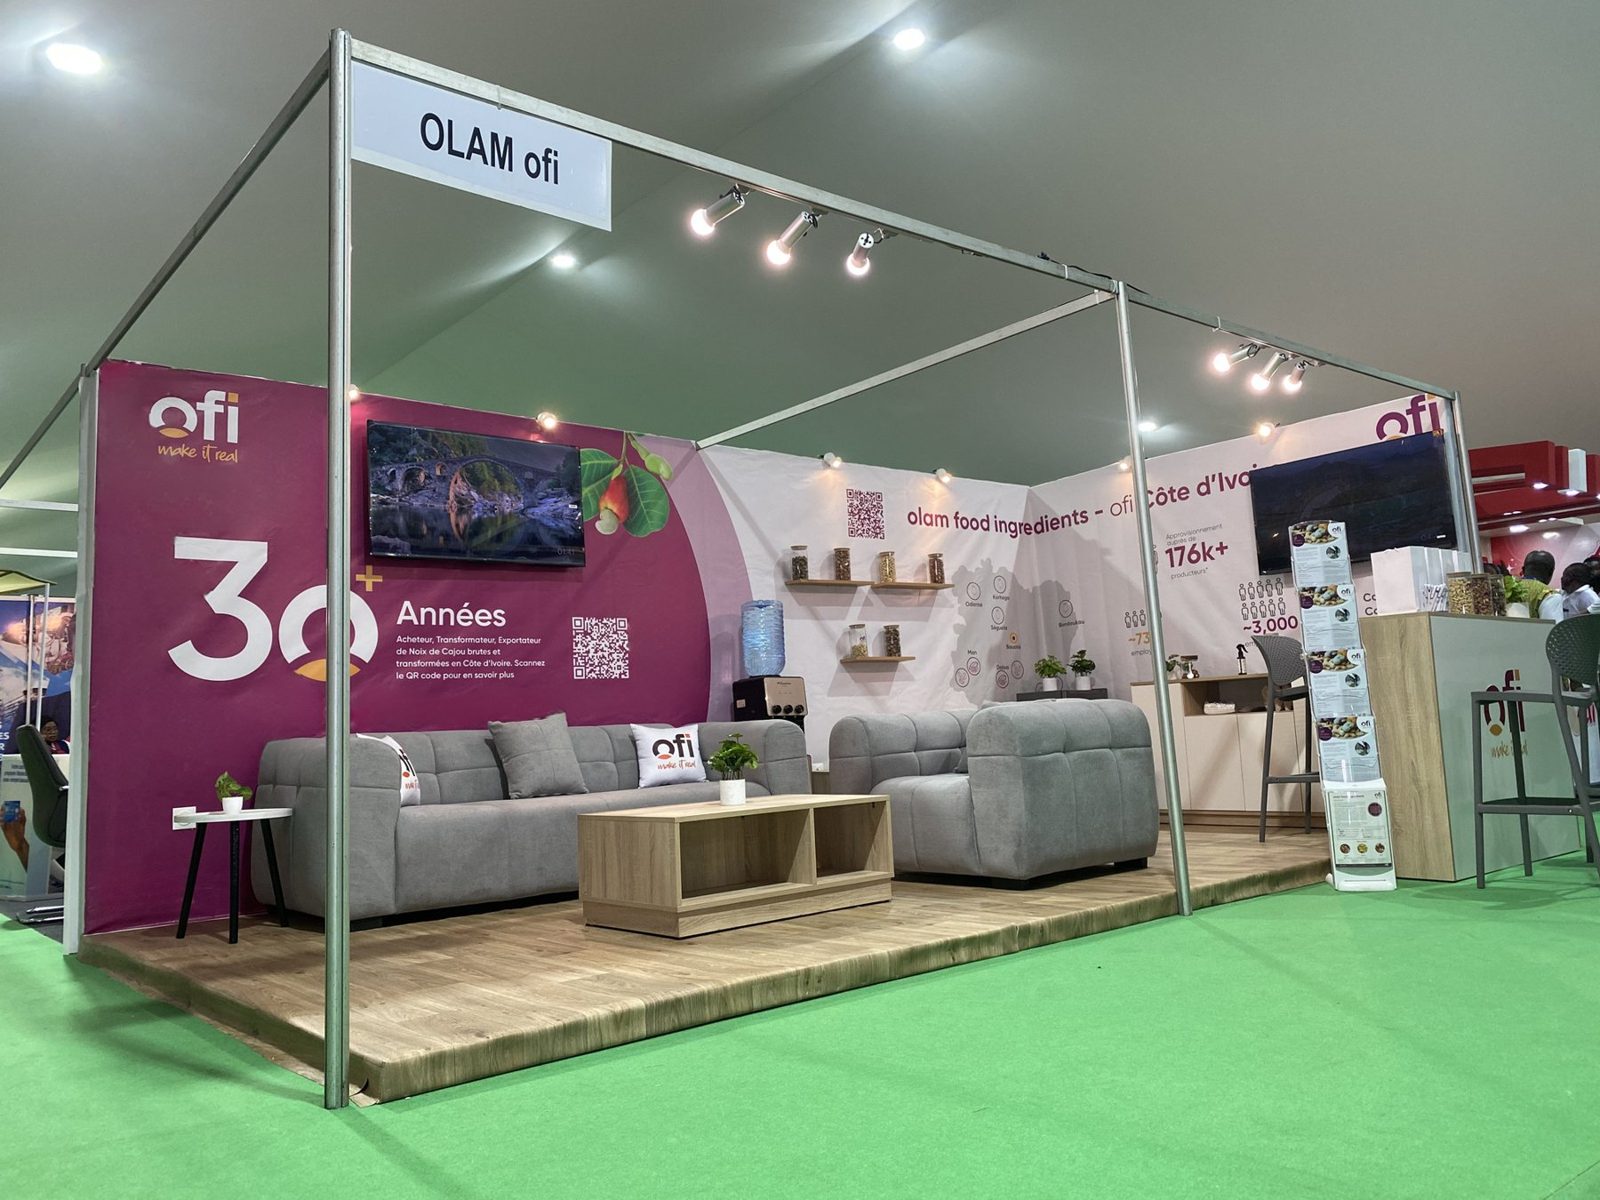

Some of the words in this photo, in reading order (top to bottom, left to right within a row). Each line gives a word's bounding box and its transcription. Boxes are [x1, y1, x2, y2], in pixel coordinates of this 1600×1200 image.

[421, 113, 513, 172] OLAM
[525, 148, 558, 184] ofi
[149, 390, 239, 443] ofi
[158, 444, 197, 458] make
[202, 444, 218, 463] it
[215, 449, 238, 463] real
[907, 507, 949, 529] olam
[953, 511, 990, 532] food
[994, 509, 1089, 539] ingredients
[1110, 494, 1133, 517] ofi
[1165, 541, 1228, 568] 176k+
[396, 600, 506, 627] Années
[1243, 615, 1298, 635] ~3,000
[396, 635, 434, 645] Acheteur,
[436, 636, 497, 645] Transformateur,
[498, 636, 541, 645] Exportateur
[395, 660, 450, 668] transformées
[463, 659, 481, 667] Côte
[483, 659, 513, 667] d'Ivoire.
[514, 659, 546, 667] Scannez
[441, 648, 466, 657] Cajou
[396, 672, 404, 680] le
[405, 671, 419, 680] QR
[421, 672, 441, 680] code
[474, 671, 498, 679] savoir
[499, 671, 515, 680] plus
[652, 733, 694, 760] ofi
